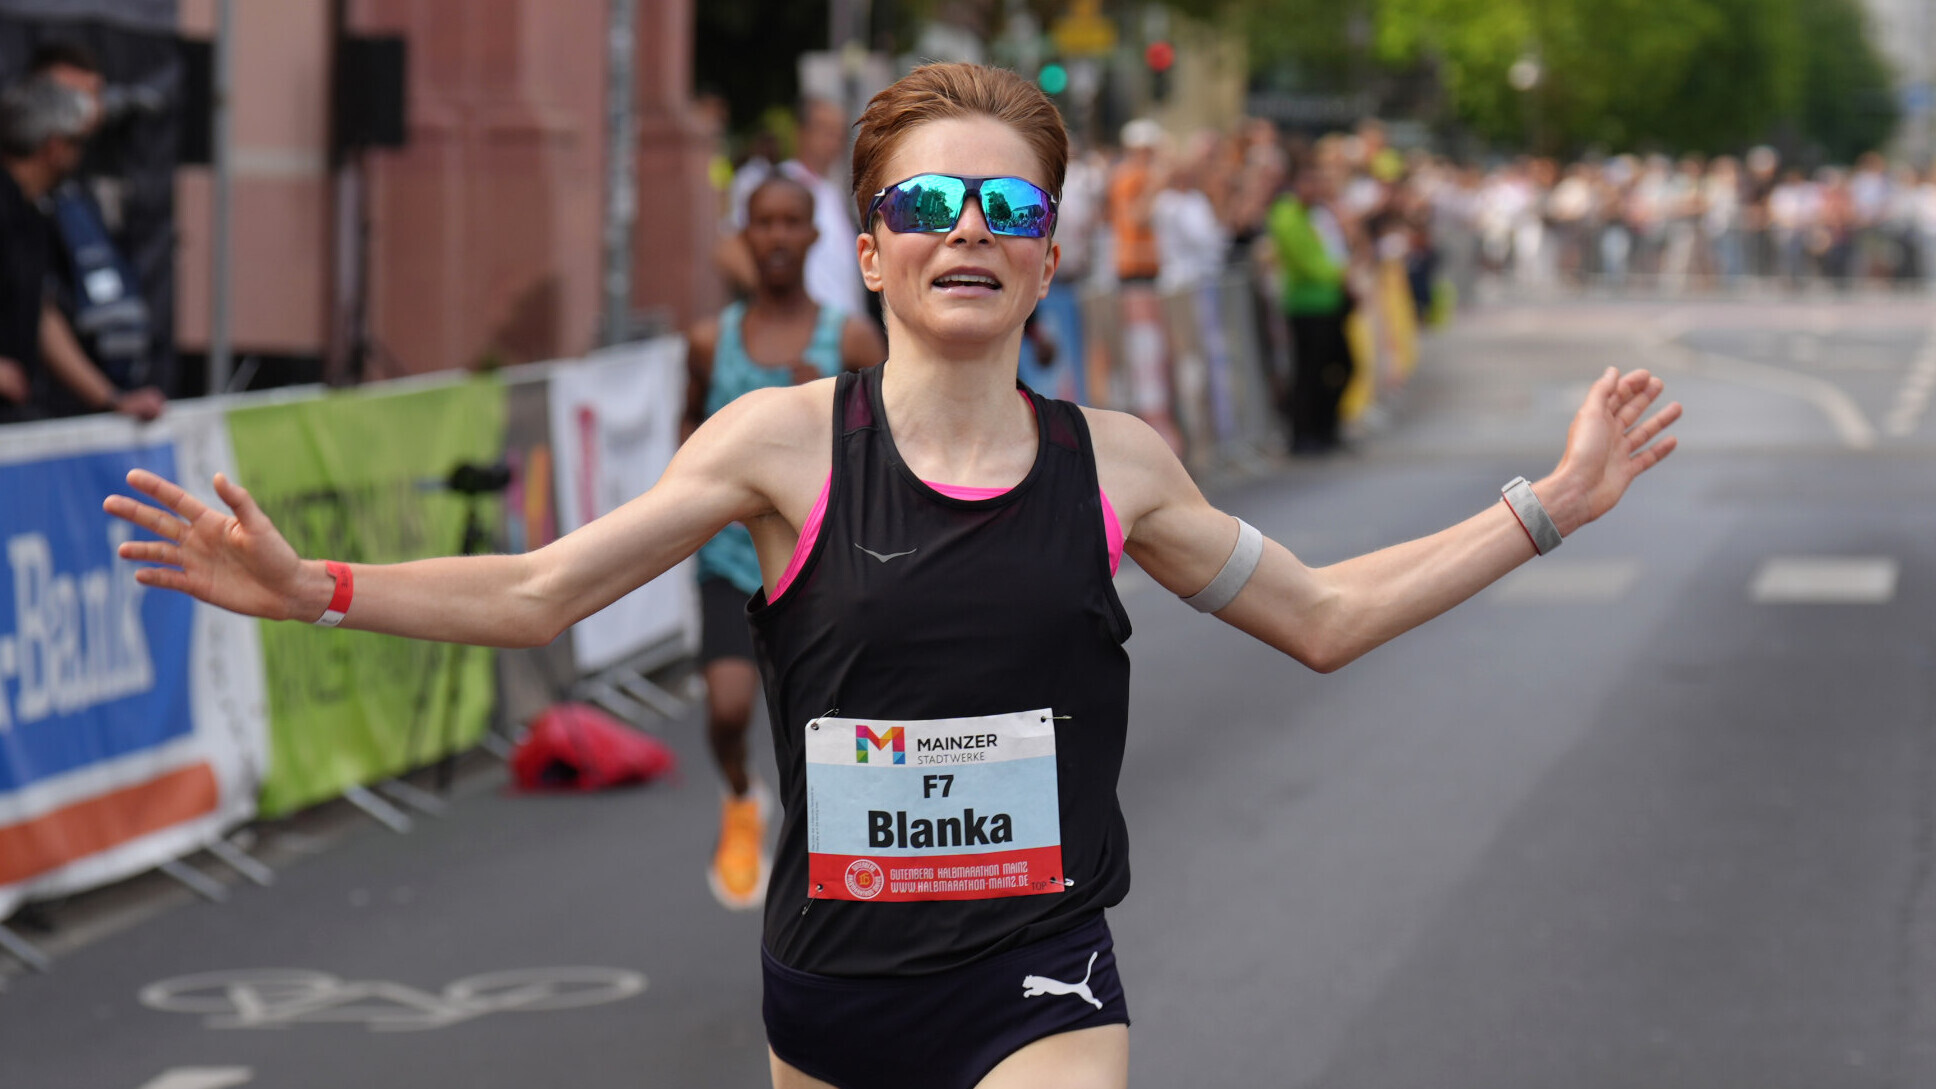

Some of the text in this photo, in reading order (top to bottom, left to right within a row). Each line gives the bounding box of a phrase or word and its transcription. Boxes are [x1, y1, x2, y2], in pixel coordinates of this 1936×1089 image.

[0, 520, 155, 727] -Bank
[917, 733, 998, 752] MAINZER
[917, 751, 986, 765] STADTWERKE
[923, 774, 955, 799] F7
[868, 808, 1013, 849] Blanka
[890, 861, 1029, 881] GUTENBERG HALBMARATHON MAINZ
[1031, 881, 1048, 892] TOP
